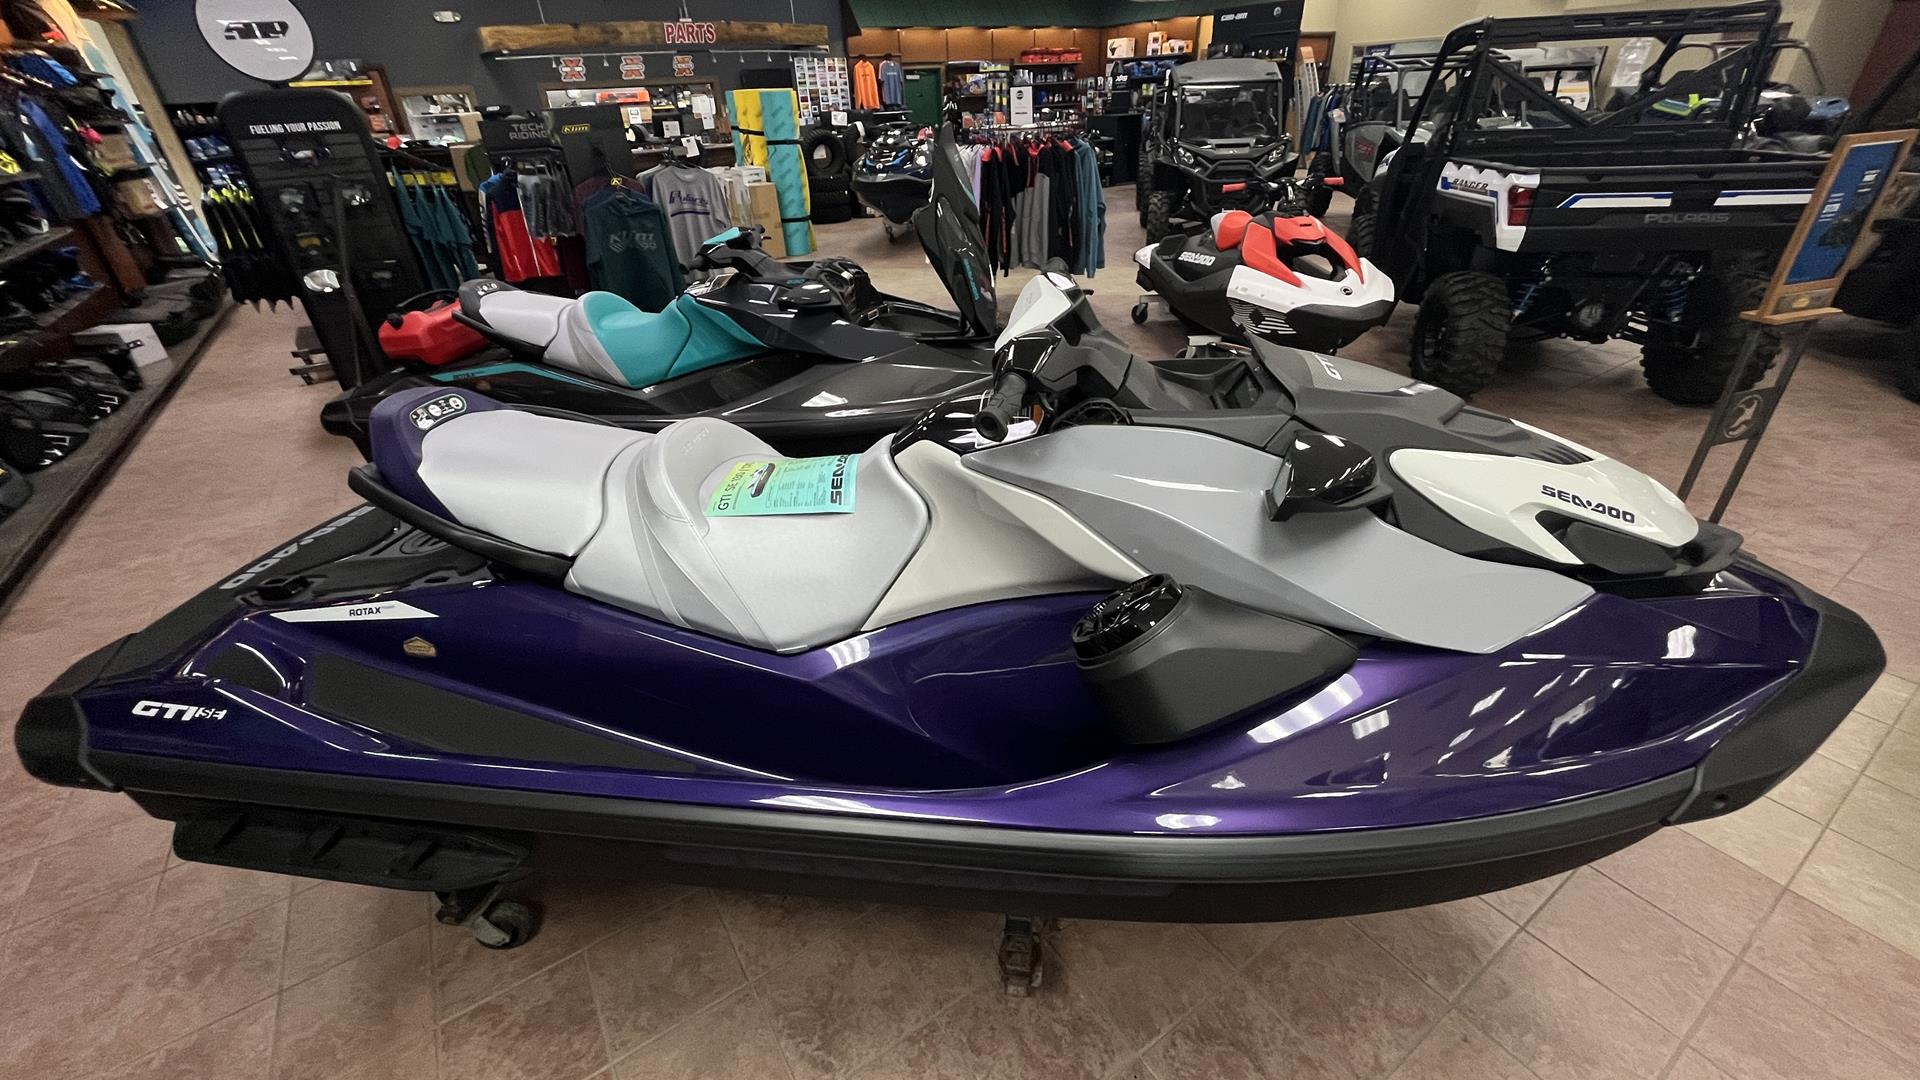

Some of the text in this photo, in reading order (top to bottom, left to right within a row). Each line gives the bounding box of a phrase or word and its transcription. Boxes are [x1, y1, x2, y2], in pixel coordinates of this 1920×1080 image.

[664, 22, 716, 44] PARTS
[249, 121, 341, 134] FUELING YOUR PASSION
[511, 122, 544, 132] TECH
[1453, 178, 1488, 190] RANGER
[1644, 212, 1729, 224] POLARIS
[717, 494, 732, 511] GTI
[349, 606, 382, 617] ROTAX
[131, 700, 198, 721] GTI
